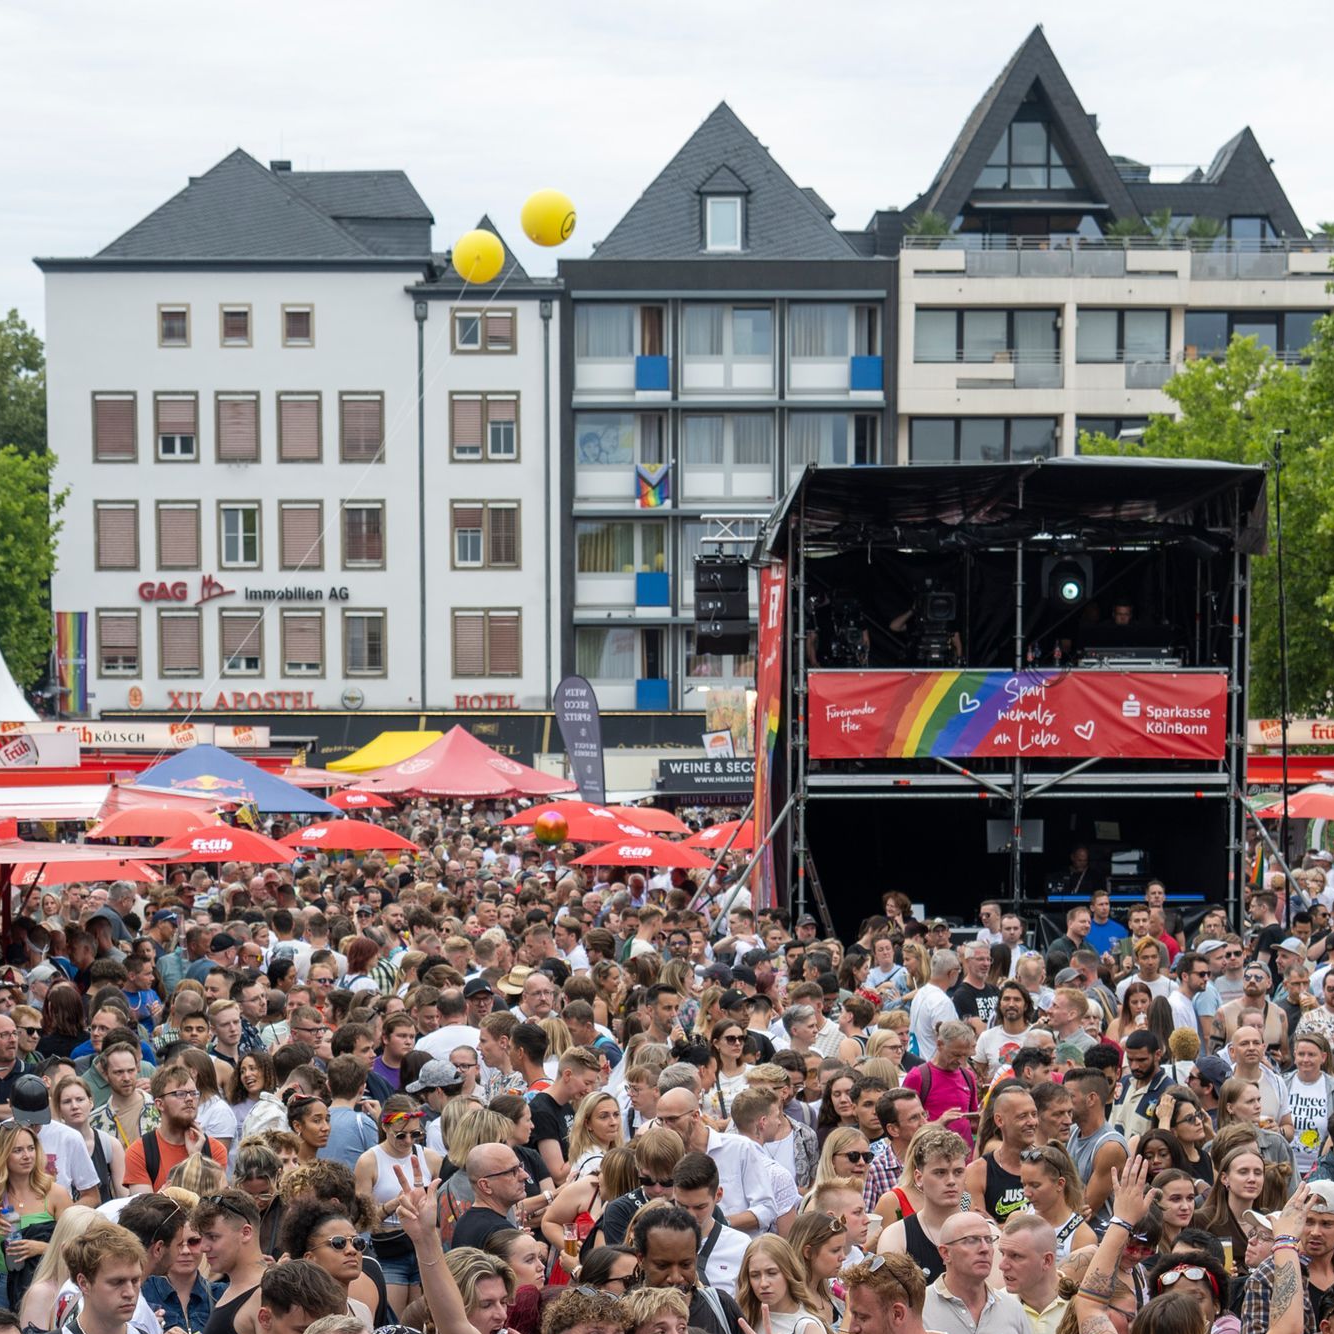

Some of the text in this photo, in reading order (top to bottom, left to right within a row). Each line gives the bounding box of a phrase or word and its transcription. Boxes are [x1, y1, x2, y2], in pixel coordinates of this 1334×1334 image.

[139, 582, 188, 601] GAG
[245, 587, 350, 601] Immobilien AG
[1004, 677, 1048, 704] Spart
[167, 691, 203, 710] XII
[214, 691, 320, 710] APOSTEL
[454, 694, 520, 709] HOTEL
[826, 701, 877, 722] Füreinander
[998, 704, 1057, 726] niemals
[1146, 705, 1211, 719] Sparkasse
[1146, 721, 1208, 735] KölnBonn
[94, 729, 146, 743] KÖLSCH
[993, 724, 1061, 752] an Liebe
[669, 761, 711, 774] WEINE
[713, 760, 724, 774] &
[1004, 1188, 1025, 1203] JUS
